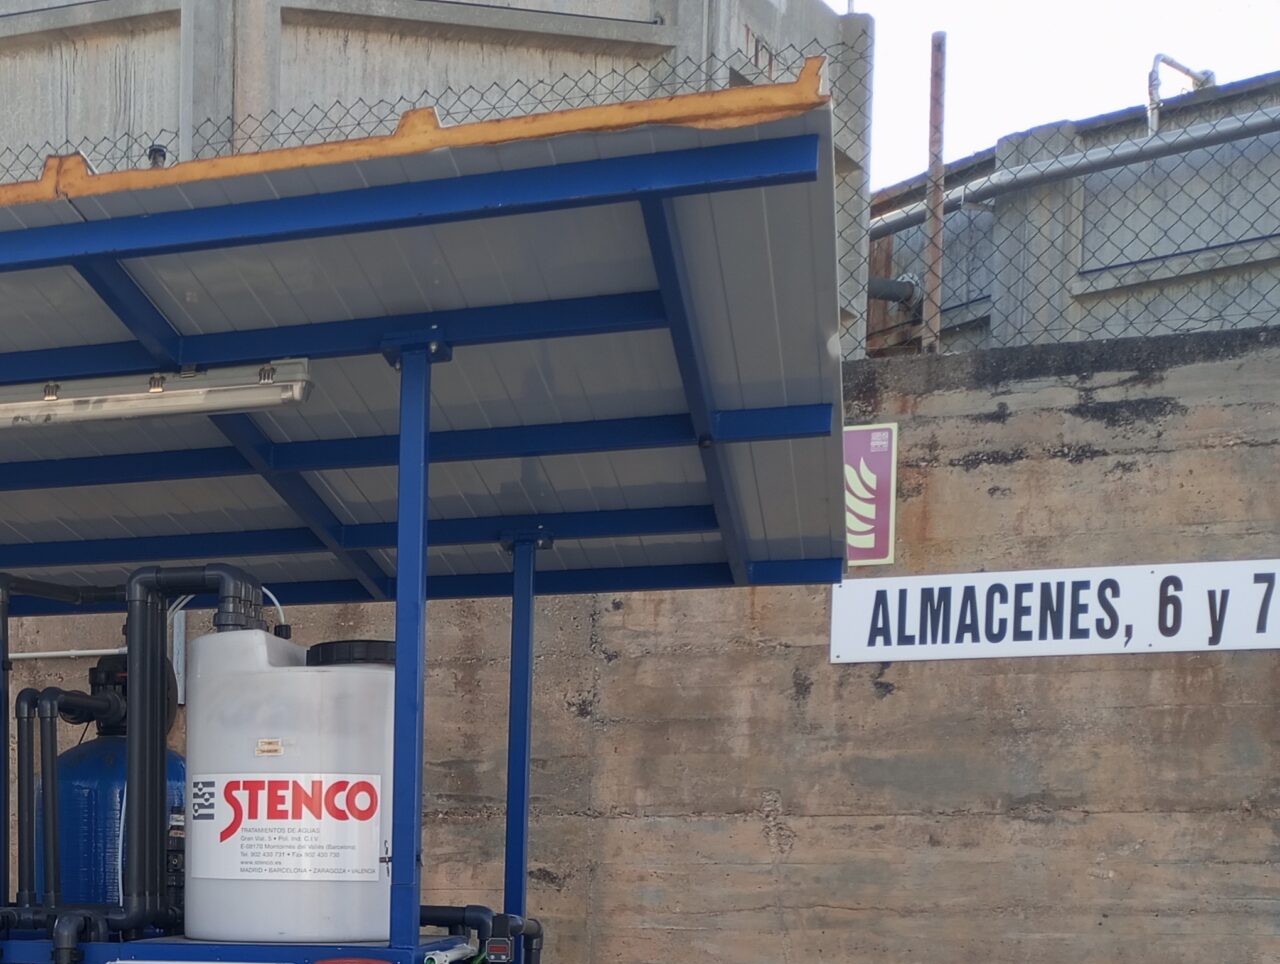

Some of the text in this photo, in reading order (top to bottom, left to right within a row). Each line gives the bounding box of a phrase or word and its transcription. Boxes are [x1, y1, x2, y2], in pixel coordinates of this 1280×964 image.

[867, 572, 1276, 648] ALMACENES, 6 y 7
[219, 780, 379, 843] STENCO
